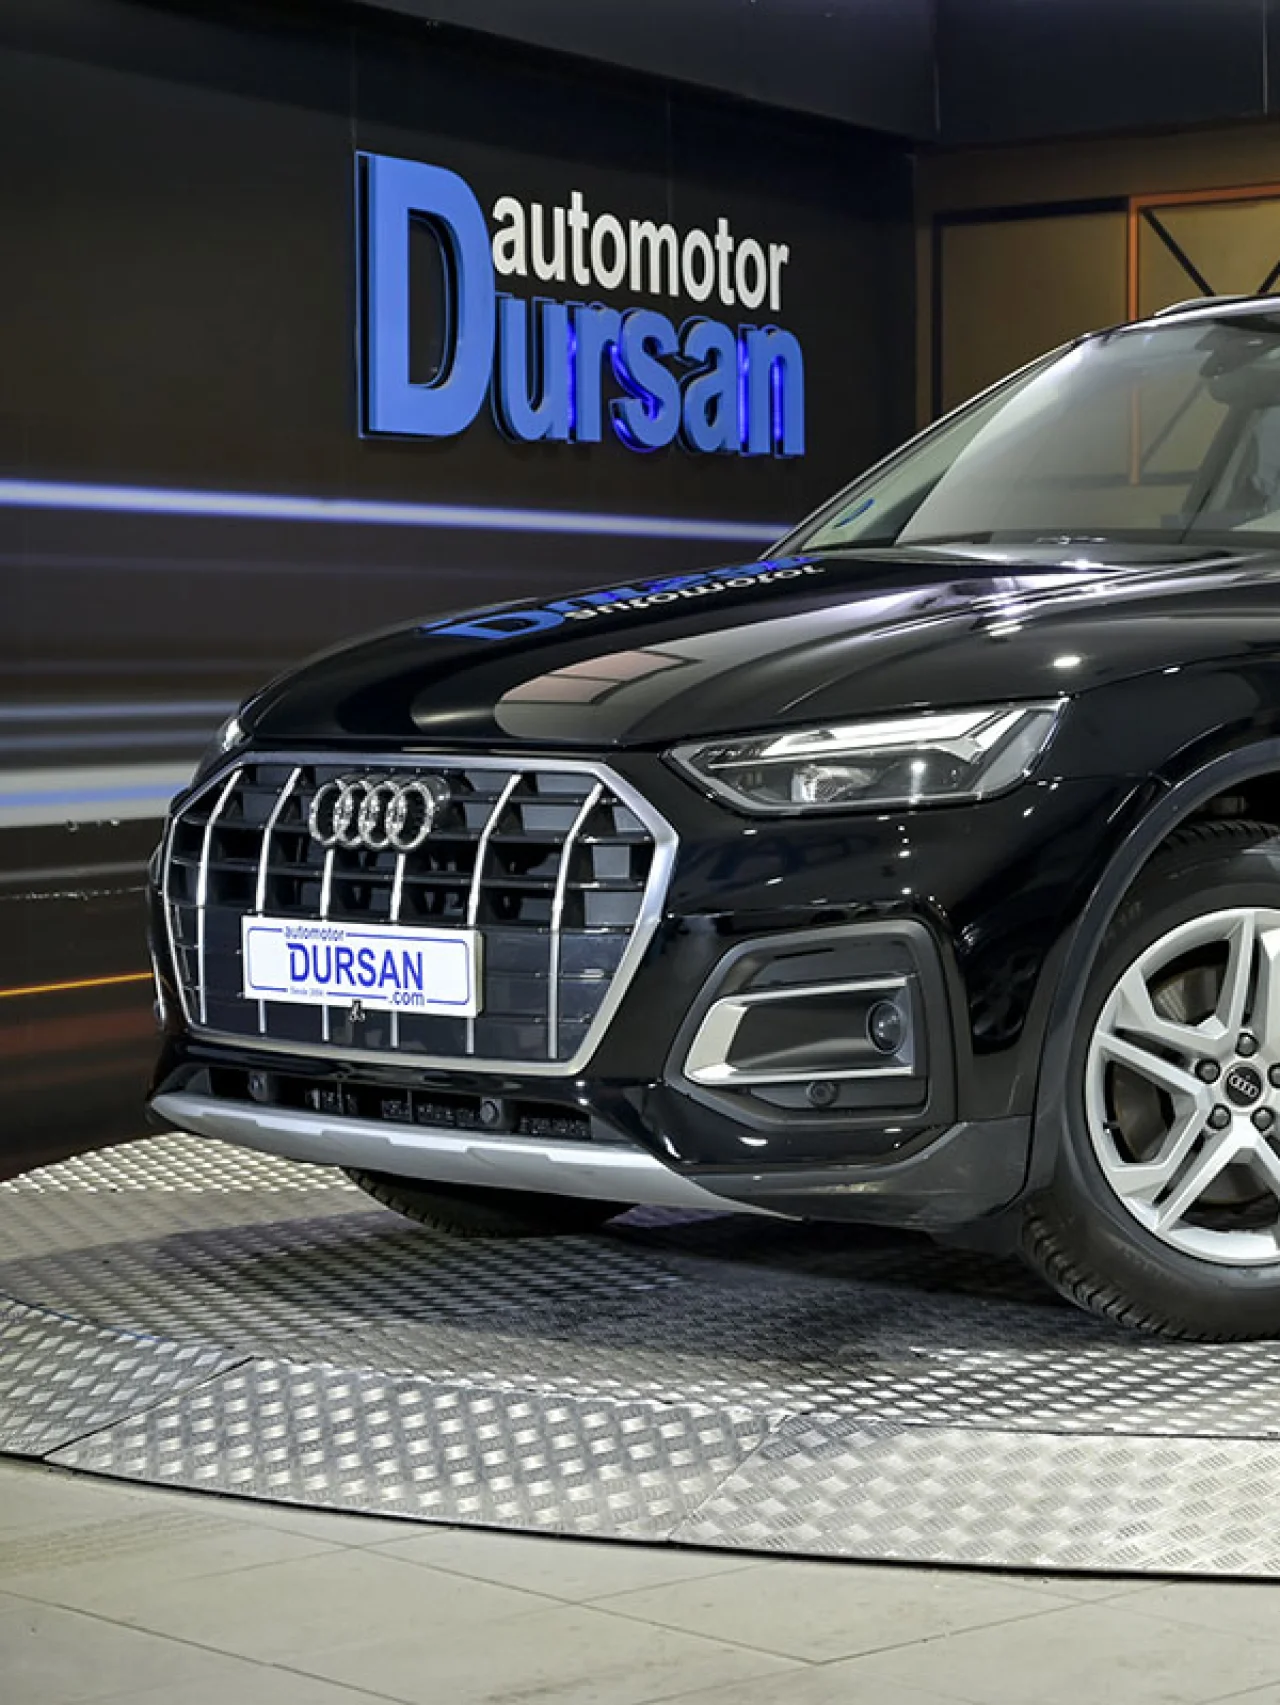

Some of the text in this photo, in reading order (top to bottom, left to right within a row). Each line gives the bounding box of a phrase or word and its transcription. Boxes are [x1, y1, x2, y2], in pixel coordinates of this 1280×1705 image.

[491, 189, 790, 311] automotor
[355, 150, 805, 459] Dursan
[284, 925, 345, 942] automotor
[286, 942, 423, 990] DURSAN
[389, 991, 425, 1008] .com
